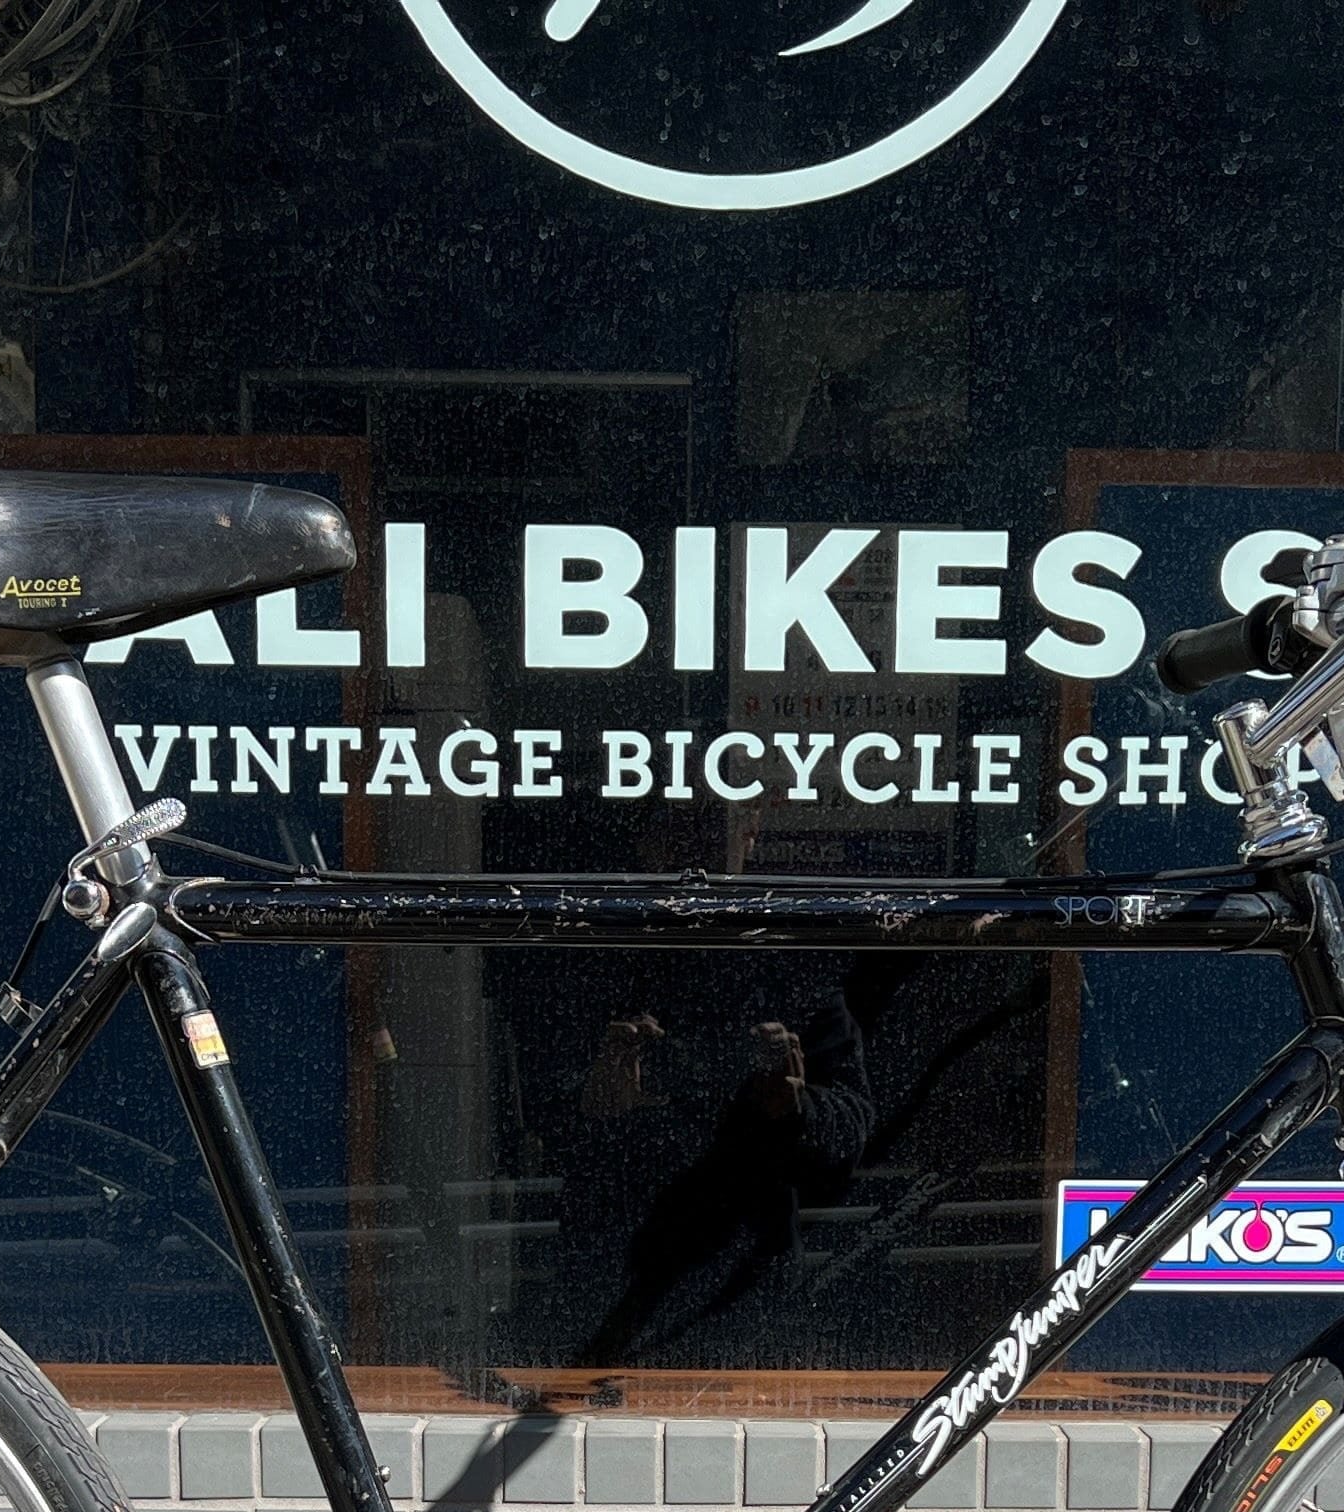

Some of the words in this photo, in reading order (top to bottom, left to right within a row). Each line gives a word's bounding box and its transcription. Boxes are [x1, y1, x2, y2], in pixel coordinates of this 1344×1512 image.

[0, 575, 81, 598] Avocet
[525, 525, 1145, 678] BIKES
[18, 597, 57, 609] TOURING
[115, 724, 562, 797] VINTAGE
[602, 730, 1020, 803] BICYCLE
[1054, 895, 1150, 927] SPORT
